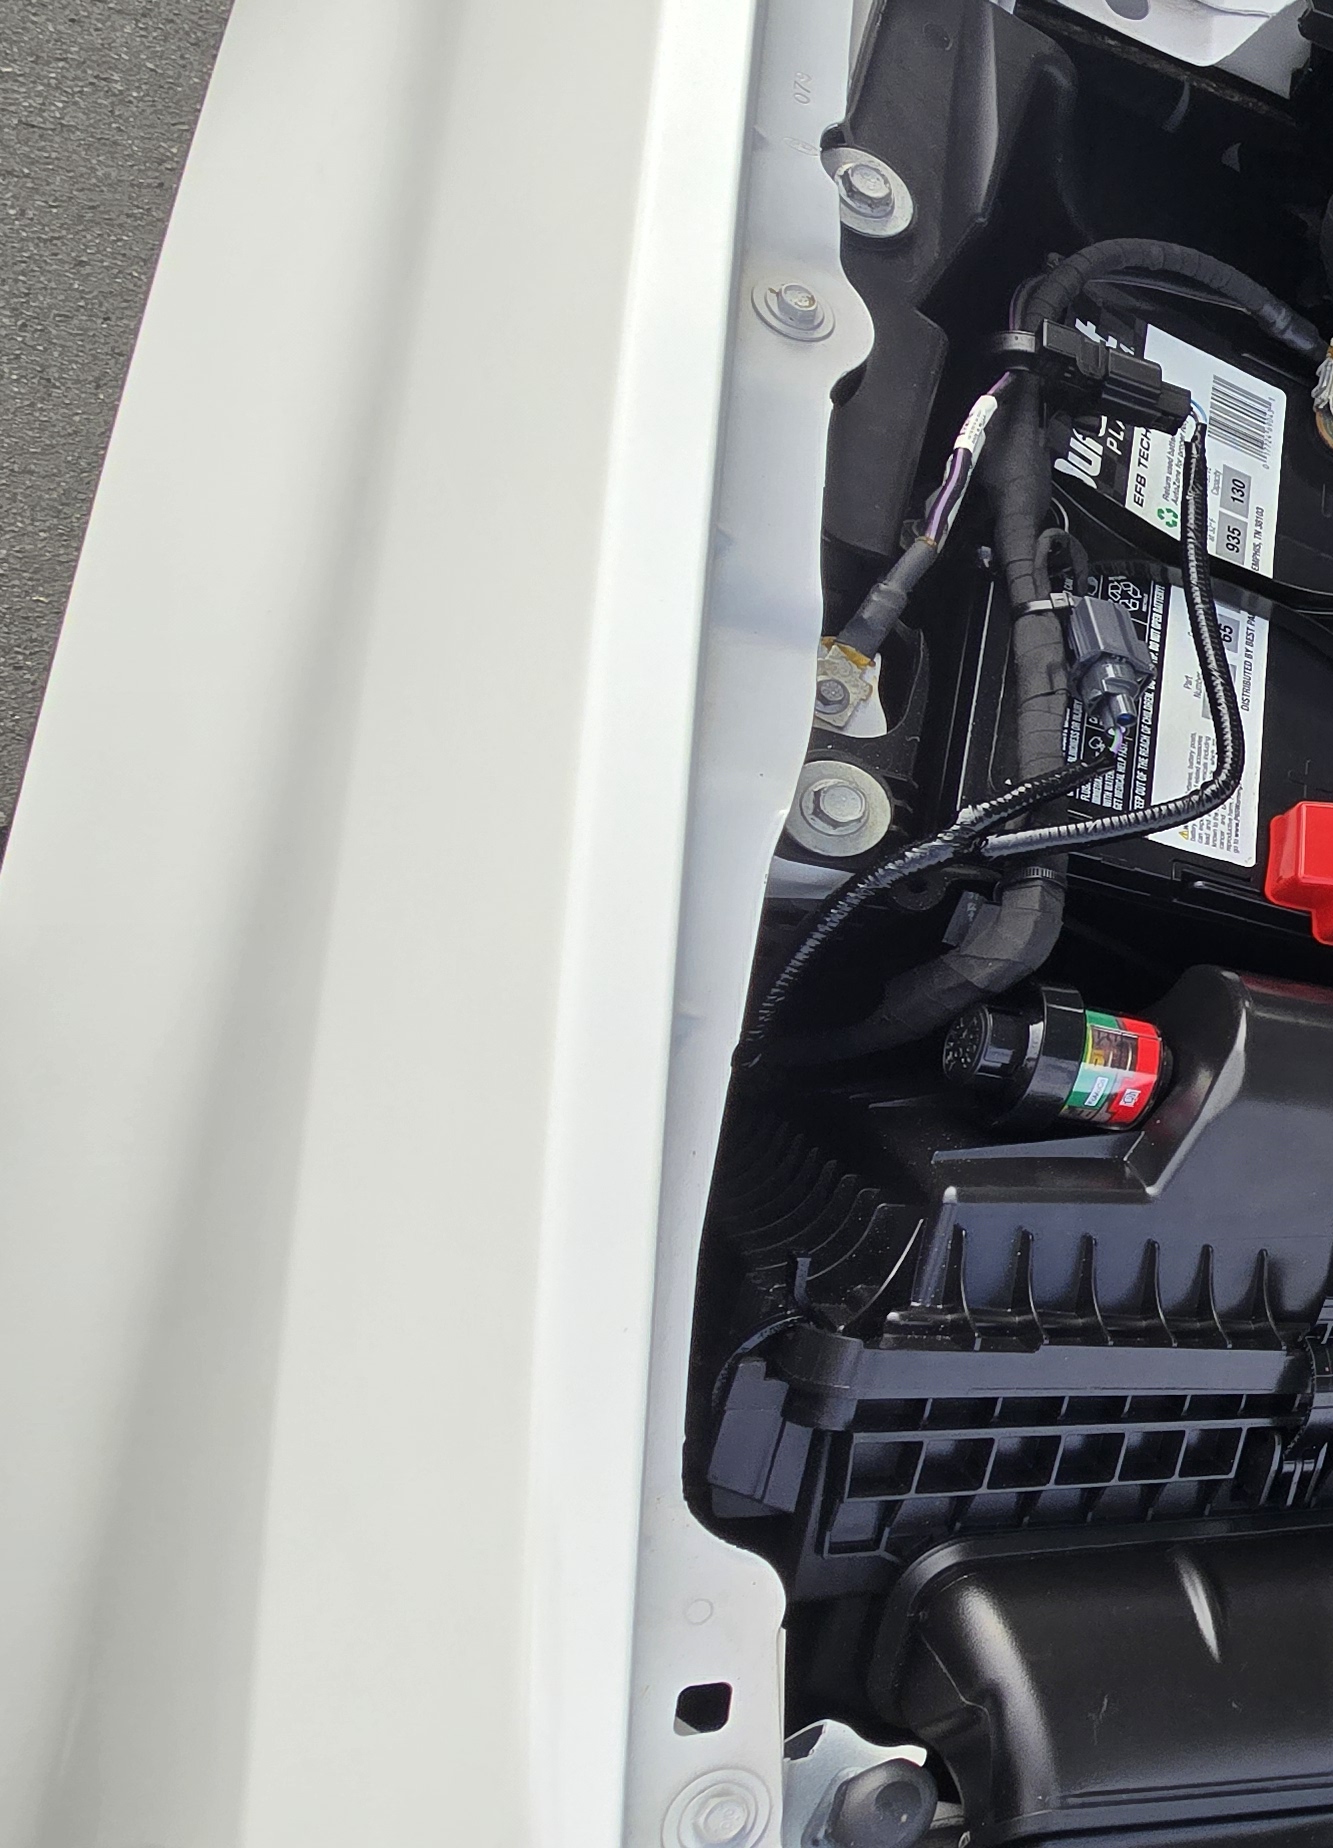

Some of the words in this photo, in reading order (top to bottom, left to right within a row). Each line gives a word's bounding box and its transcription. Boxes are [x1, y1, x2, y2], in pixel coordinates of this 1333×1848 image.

[1133, 474, 1147, 508] EFB
[1162, 476, 1171, 501] Return
[1211, 468, 1222, 496] Capacity
[1231, 478, 1246, 504] 130
[1255, 506, 1265, 530] 38103
[1226, 525, 1241, 553] 935
[1251, 542, 1262, 571] EMPHIS,
[1152, 612, 1162, 629] OPEN
[1150, 628, 1161, 642] NOT
[1246, 627, 1256, 647] BEST
[1245, 647, 1254, 659] BY
[1183, 674, 1194, 690] Part
[1241, 660, 1253, 711] DISTRIBUTED
[1141, 724, 1152, 735] OF
[1139, 738, 1151, 758] REACH
[1117, 757, 1127, 773] HELP
[1138, 757, 1149, 770] THE
[1137, 770, 1147, 781] OF
[1114, 774, 1126, 798] MEDICAL
[1135, 782, 1146, 795] OUT
[1113, 798, 1123, 810] GET
[1134, 794, 1145, 810] EEP
